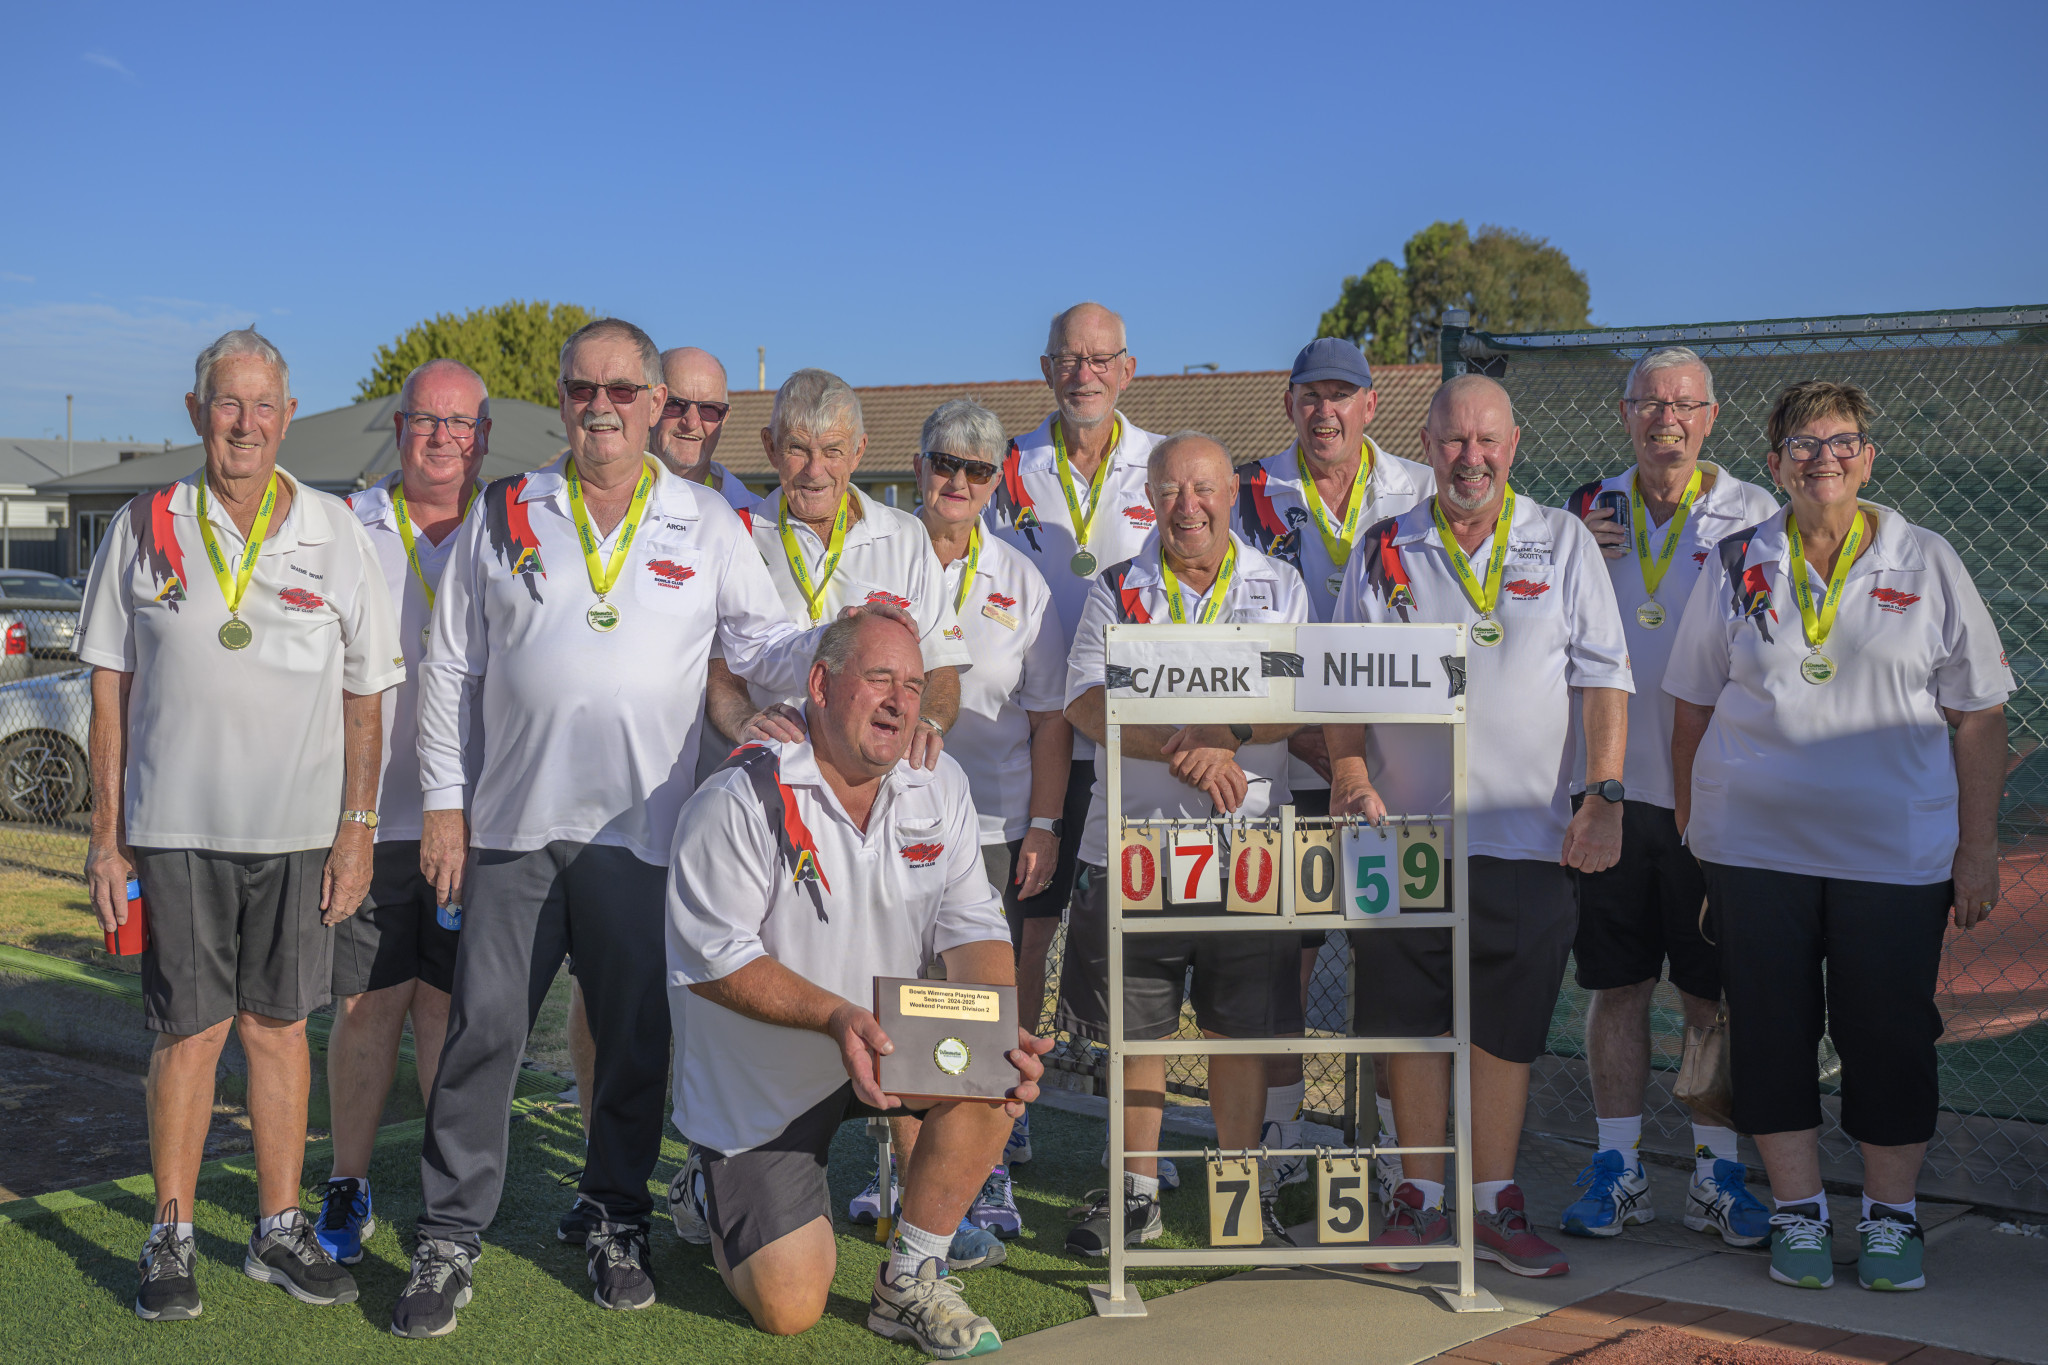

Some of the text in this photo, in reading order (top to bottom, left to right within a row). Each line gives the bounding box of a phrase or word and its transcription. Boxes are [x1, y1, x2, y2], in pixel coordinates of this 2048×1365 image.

[580, 522, 593, 554] Wimmera
[617, 523, 633, 552] Wimmera
[666, 523, 686, 531] ARCH
[210, 541, 224, 573] Wimmera
[242, 542, 257, 572] Wimmera
[1131, 664, 1250, 698] C/PARK
[1324, 652, 1432, 688] NHILL
[1216, 1180, 1250, 1236] 7
[1328, 1177, 1364, 1233] 5
